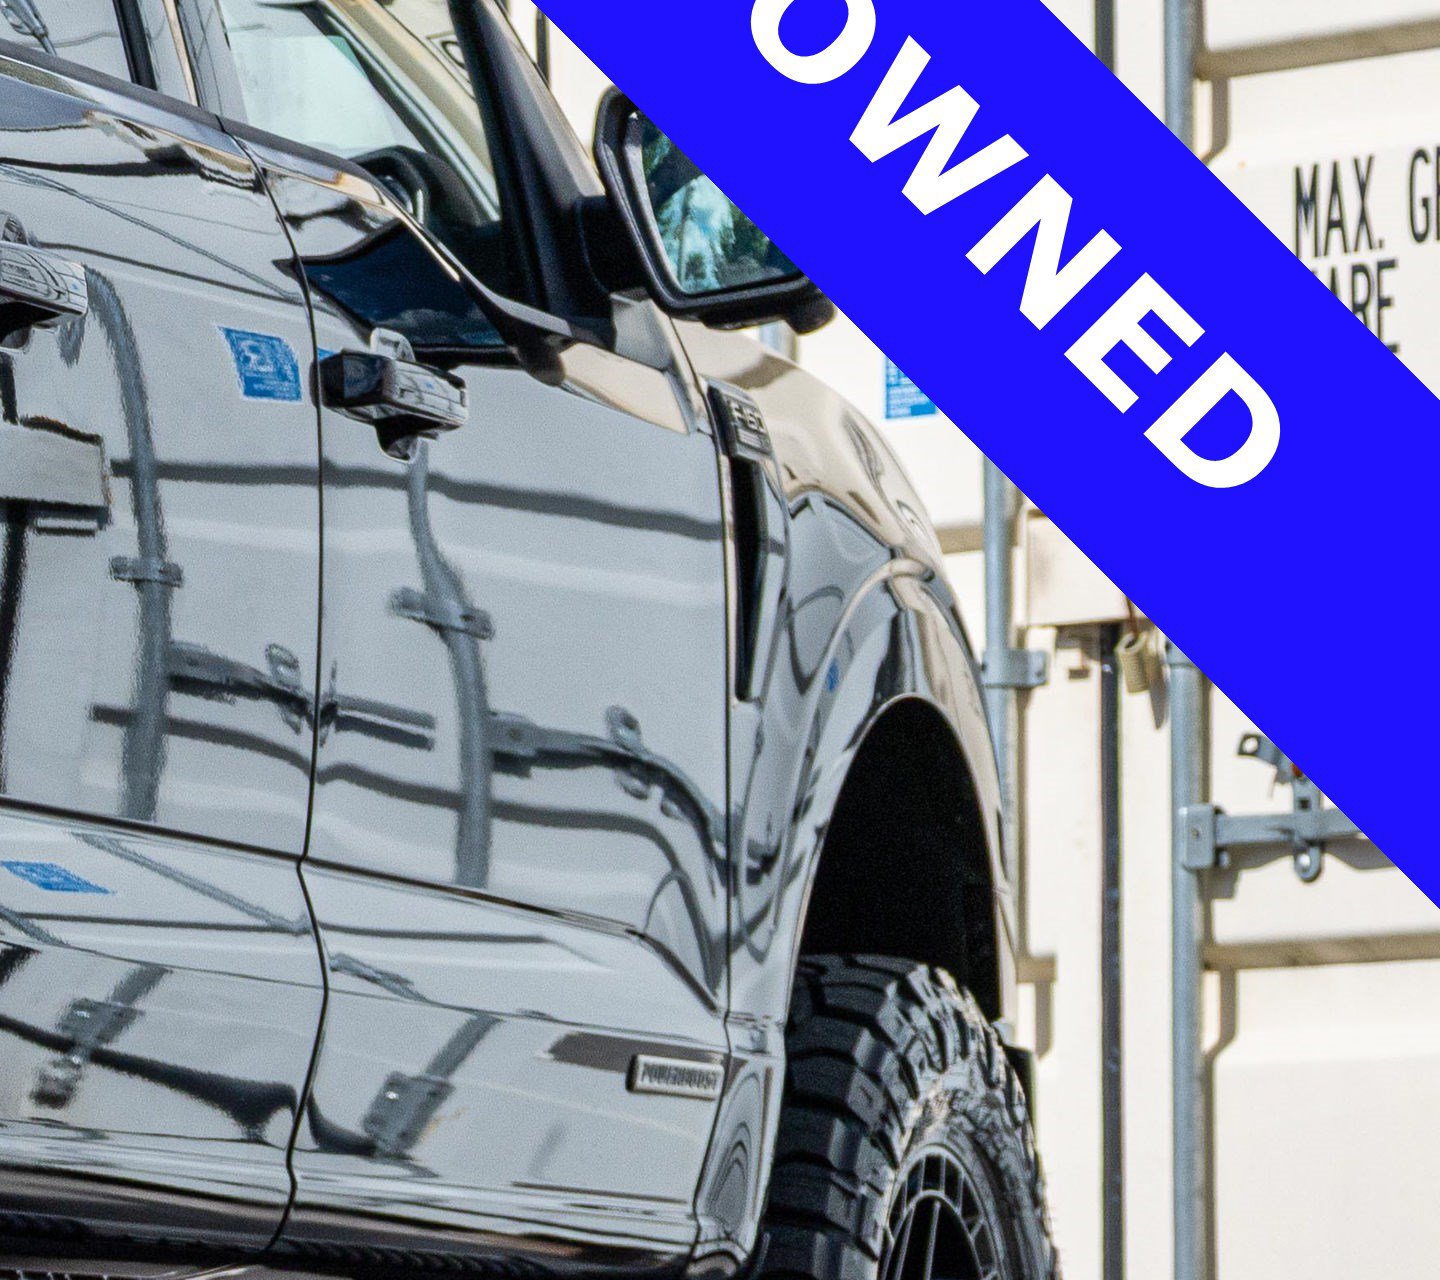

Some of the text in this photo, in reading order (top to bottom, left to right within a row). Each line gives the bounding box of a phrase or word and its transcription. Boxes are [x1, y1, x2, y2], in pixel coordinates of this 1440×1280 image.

[1294, 145, 1440, 259] MAX. G
[1310, 258, 1400, 354] RE
